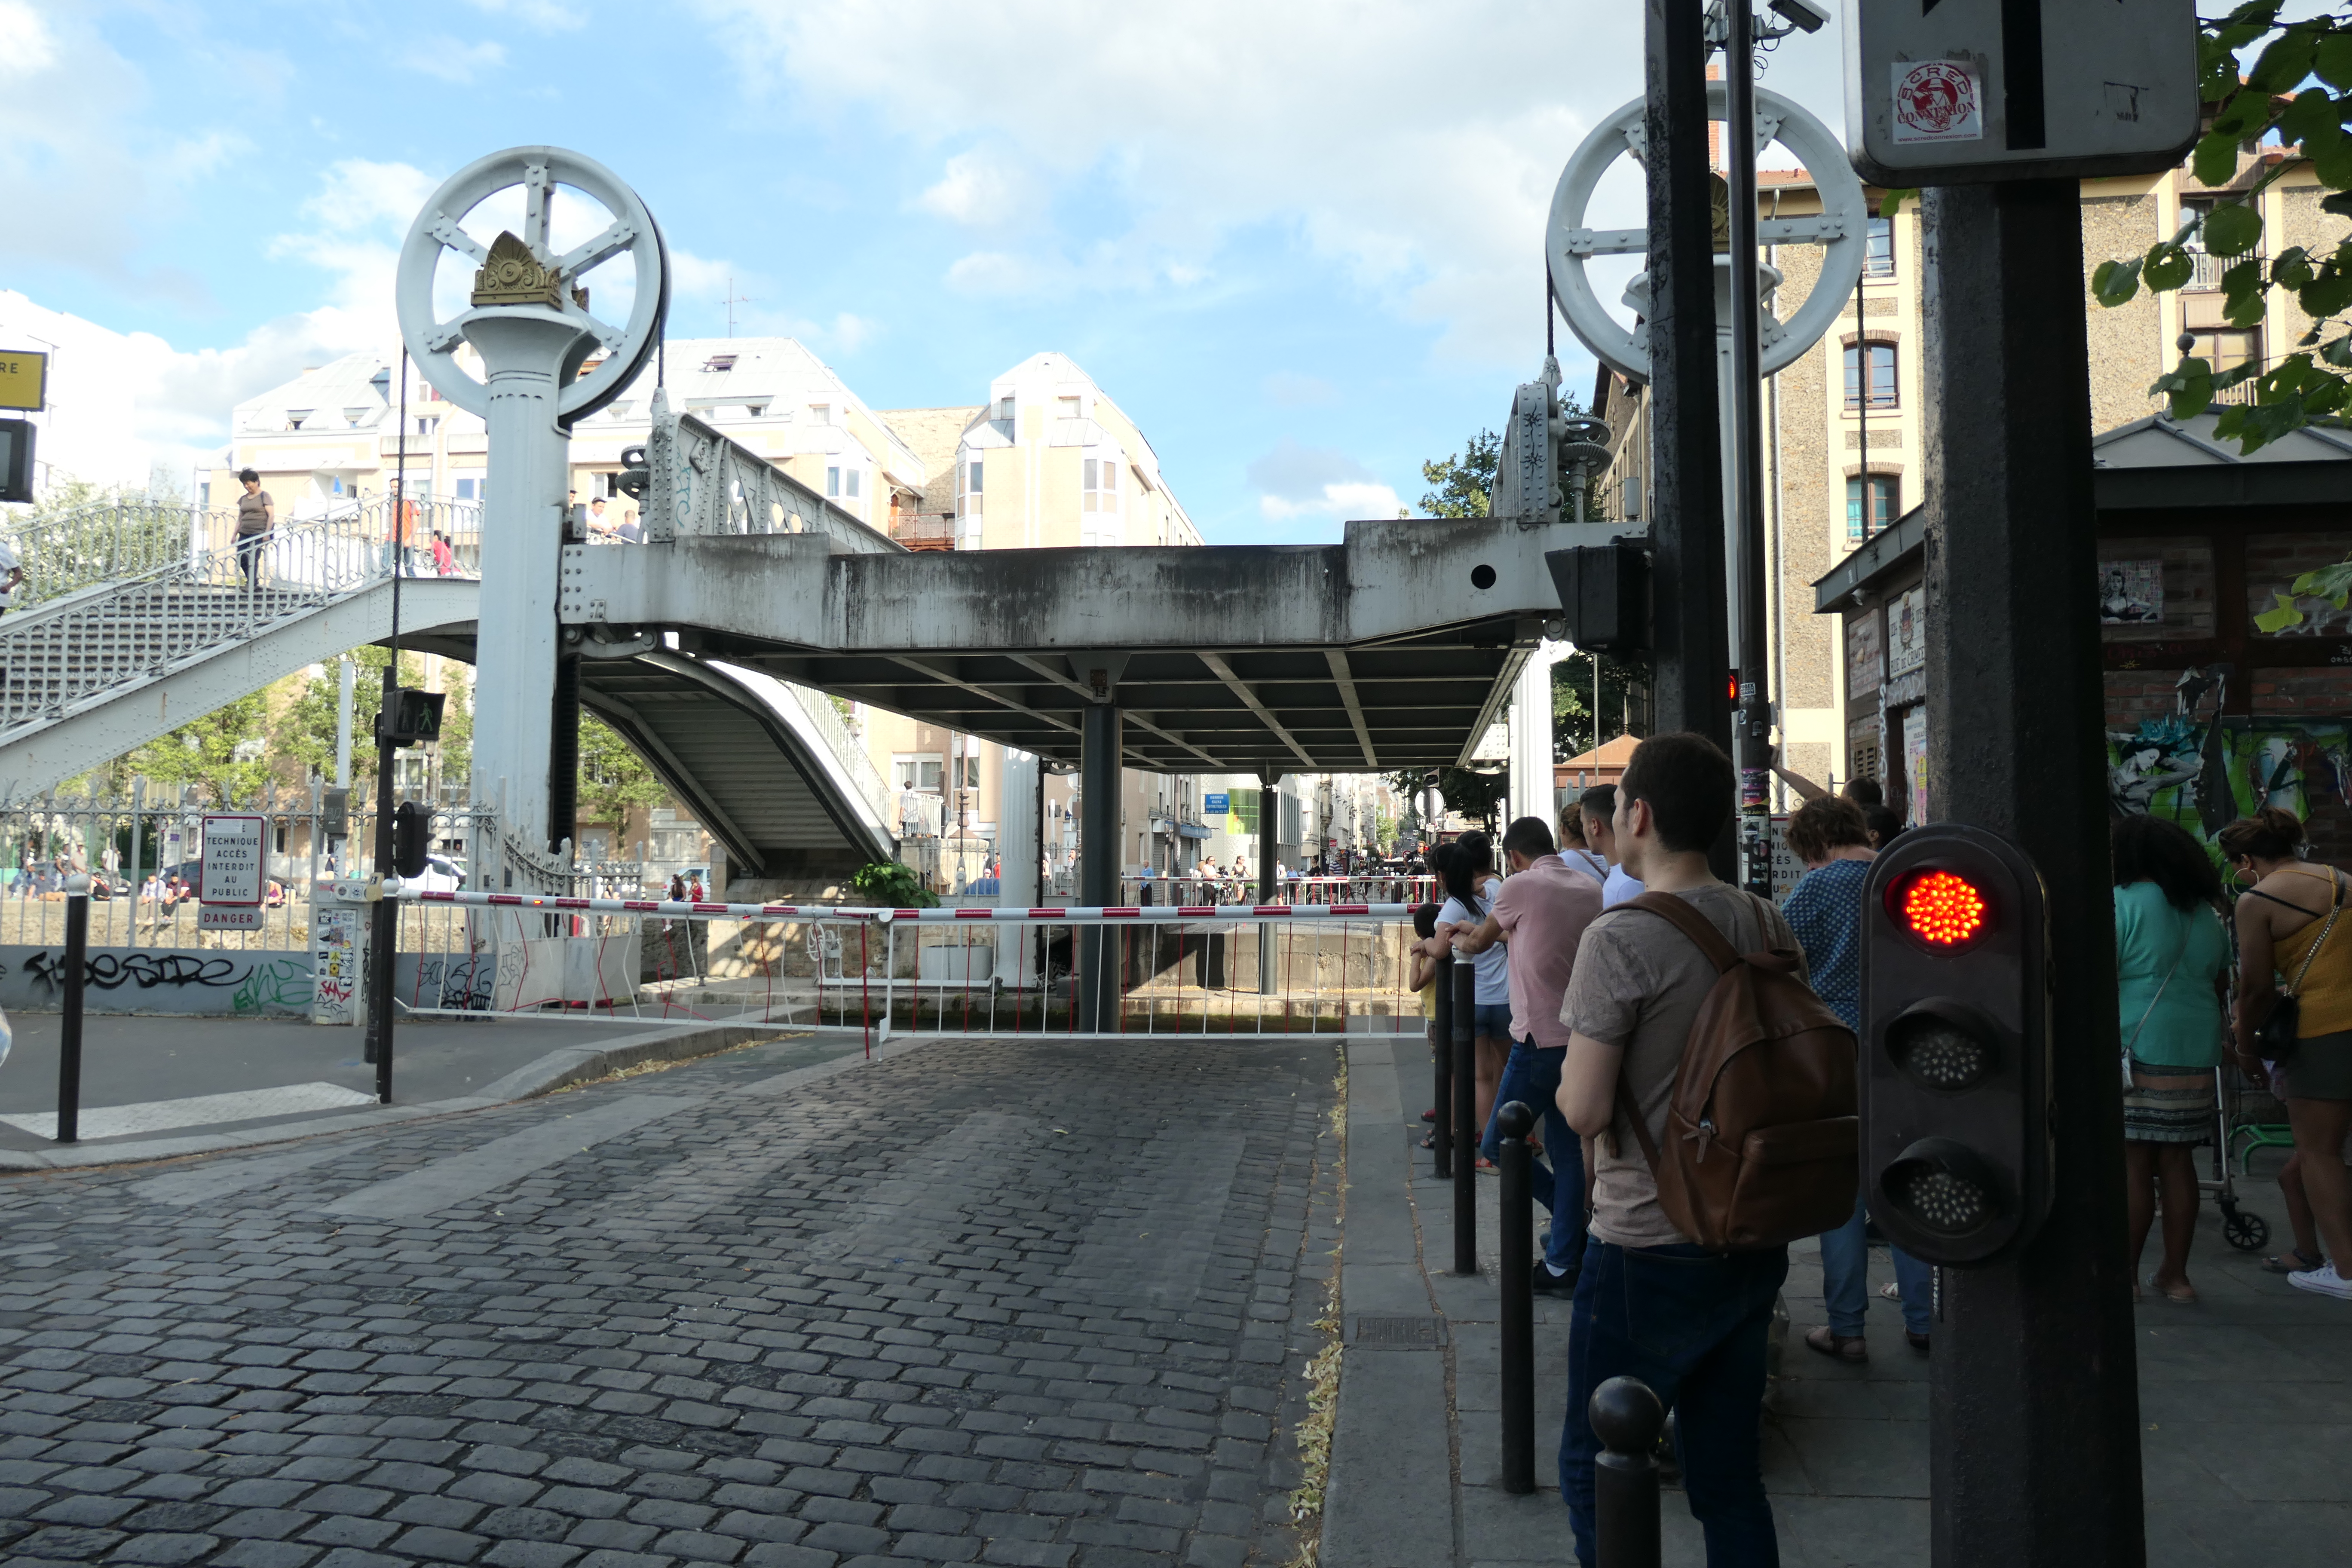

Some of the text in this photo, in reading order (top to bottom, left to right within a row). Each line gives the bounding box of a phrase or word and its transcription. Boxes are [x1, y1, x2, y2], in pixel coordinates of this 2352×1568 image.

[1901, 67, 1969, 101] SCRED
[1897, 101, 1975, 124] CONNEXION
[1898, 133, 1977, 142] www.scredconnexion.com
[217, 849, 247, 858] ACCÈS
[204, 913, 253, 923] DANGER
